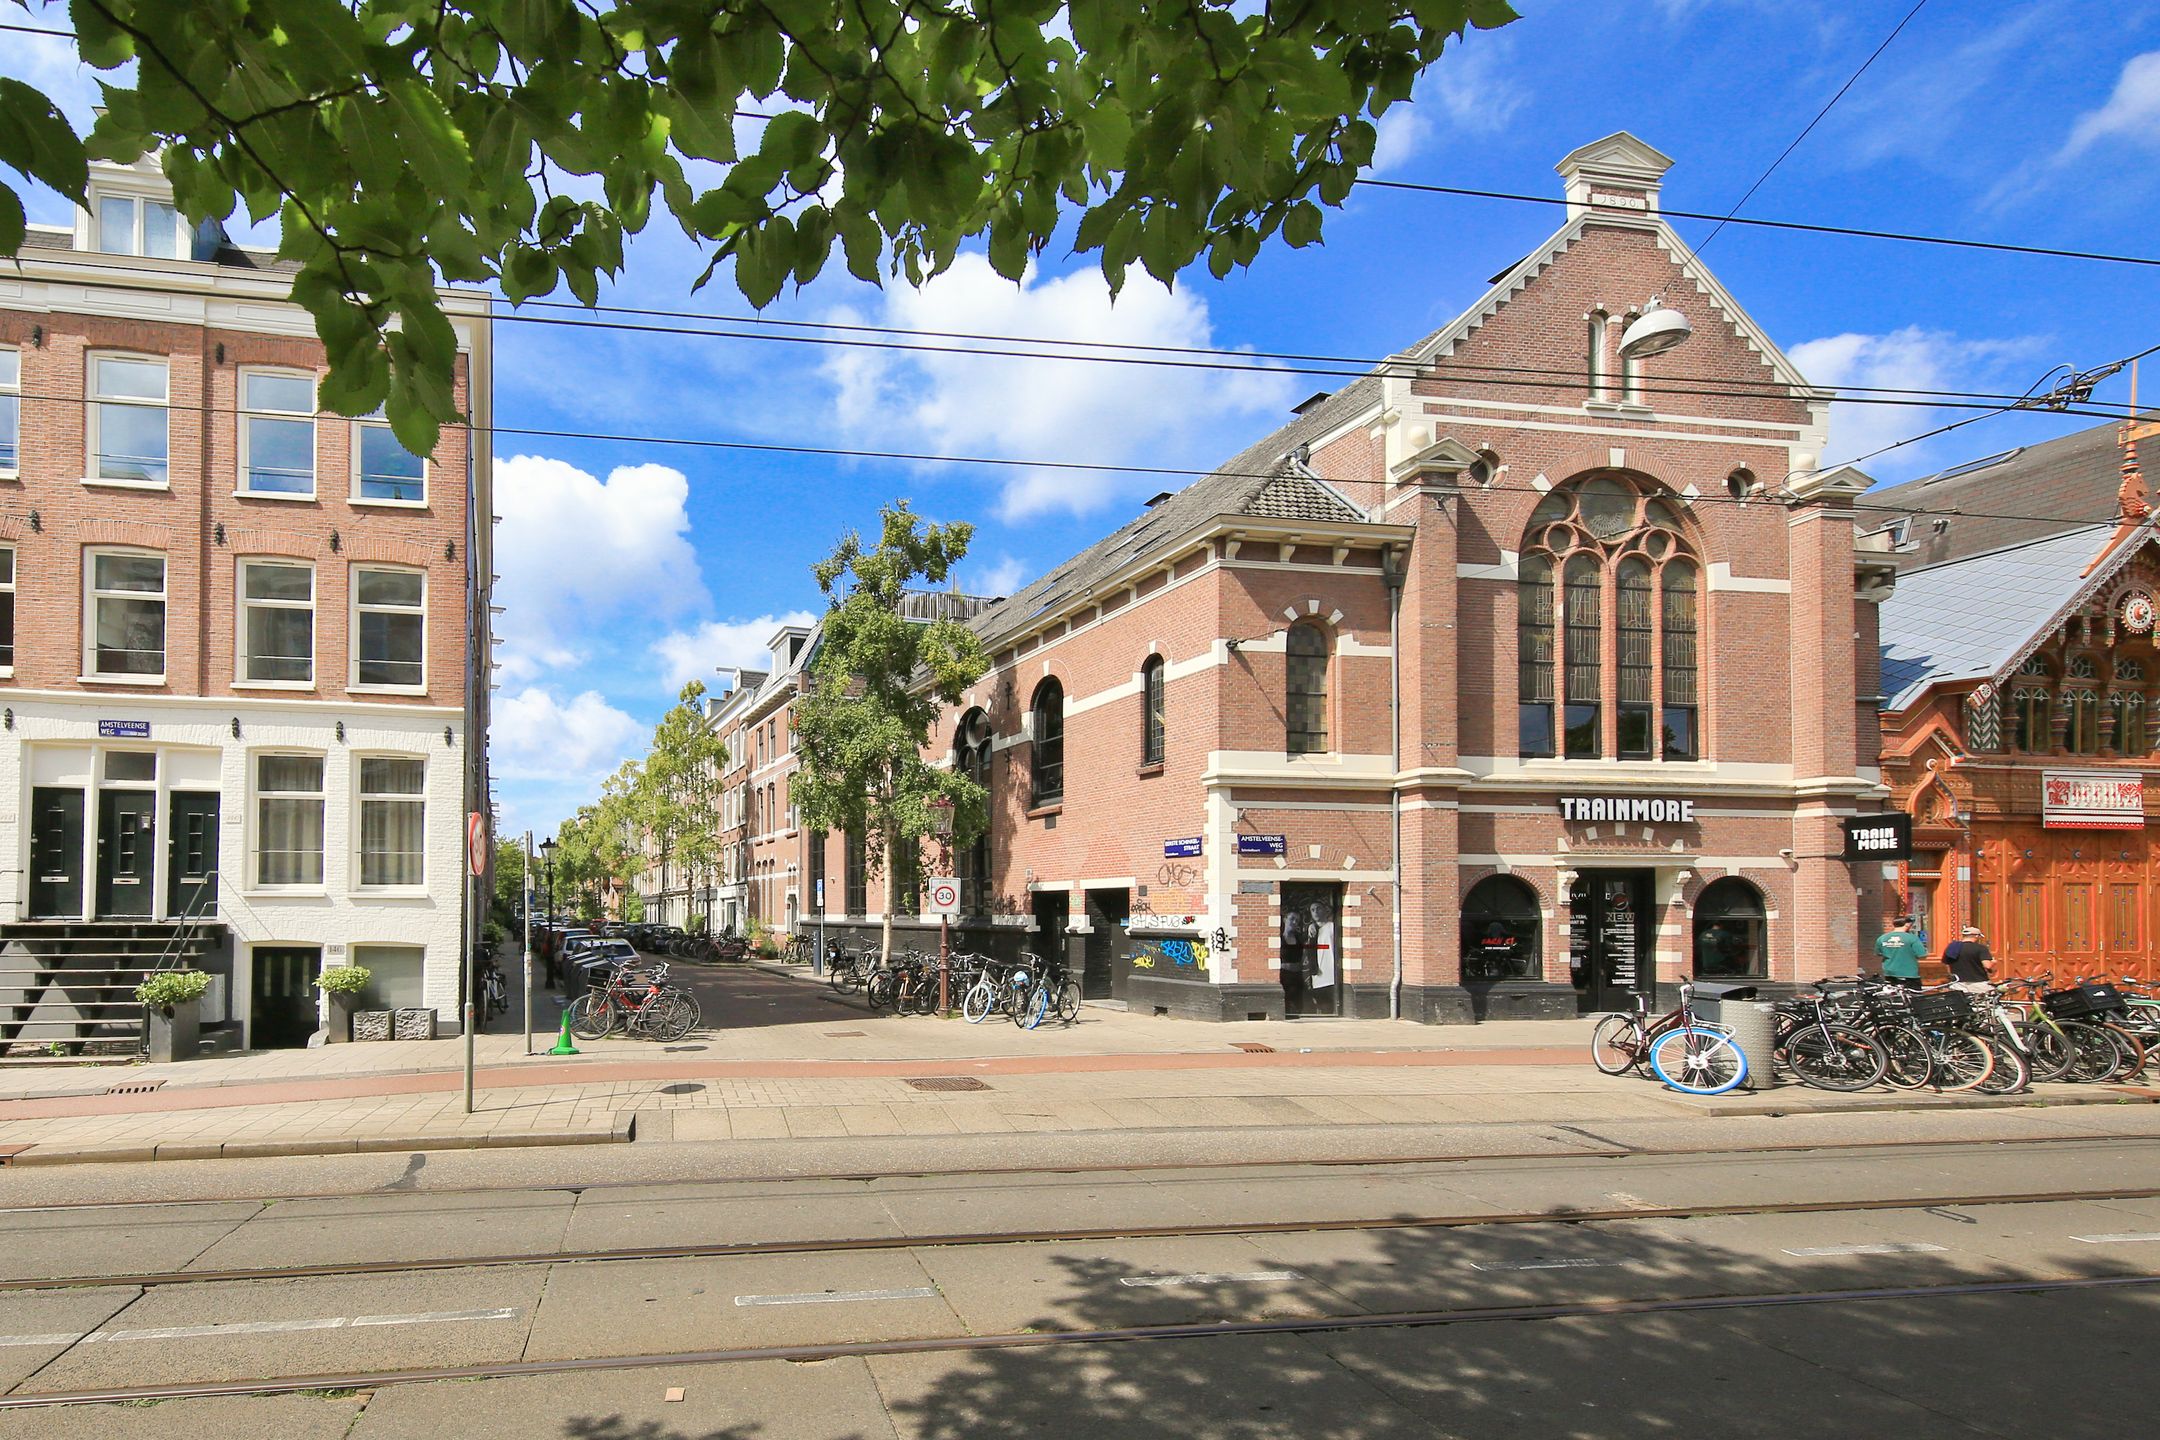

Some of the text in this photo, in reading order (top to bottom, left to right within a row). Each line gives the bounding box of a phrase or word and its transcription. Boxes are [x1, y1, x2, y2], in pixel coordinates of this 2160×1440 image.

[1600, 196, 1636, 208] 1890
[100, 721, 147, 730] AMSTELVEENSE
[1560, 798, 1694, 822] TRAINMORE
[1851, 827, 1895, 841] TRAIN
[1857, 837, 1898, 851] MORE
[938, 891, 952, 900] 30
[1605, 911, 1635, 923] NEW
